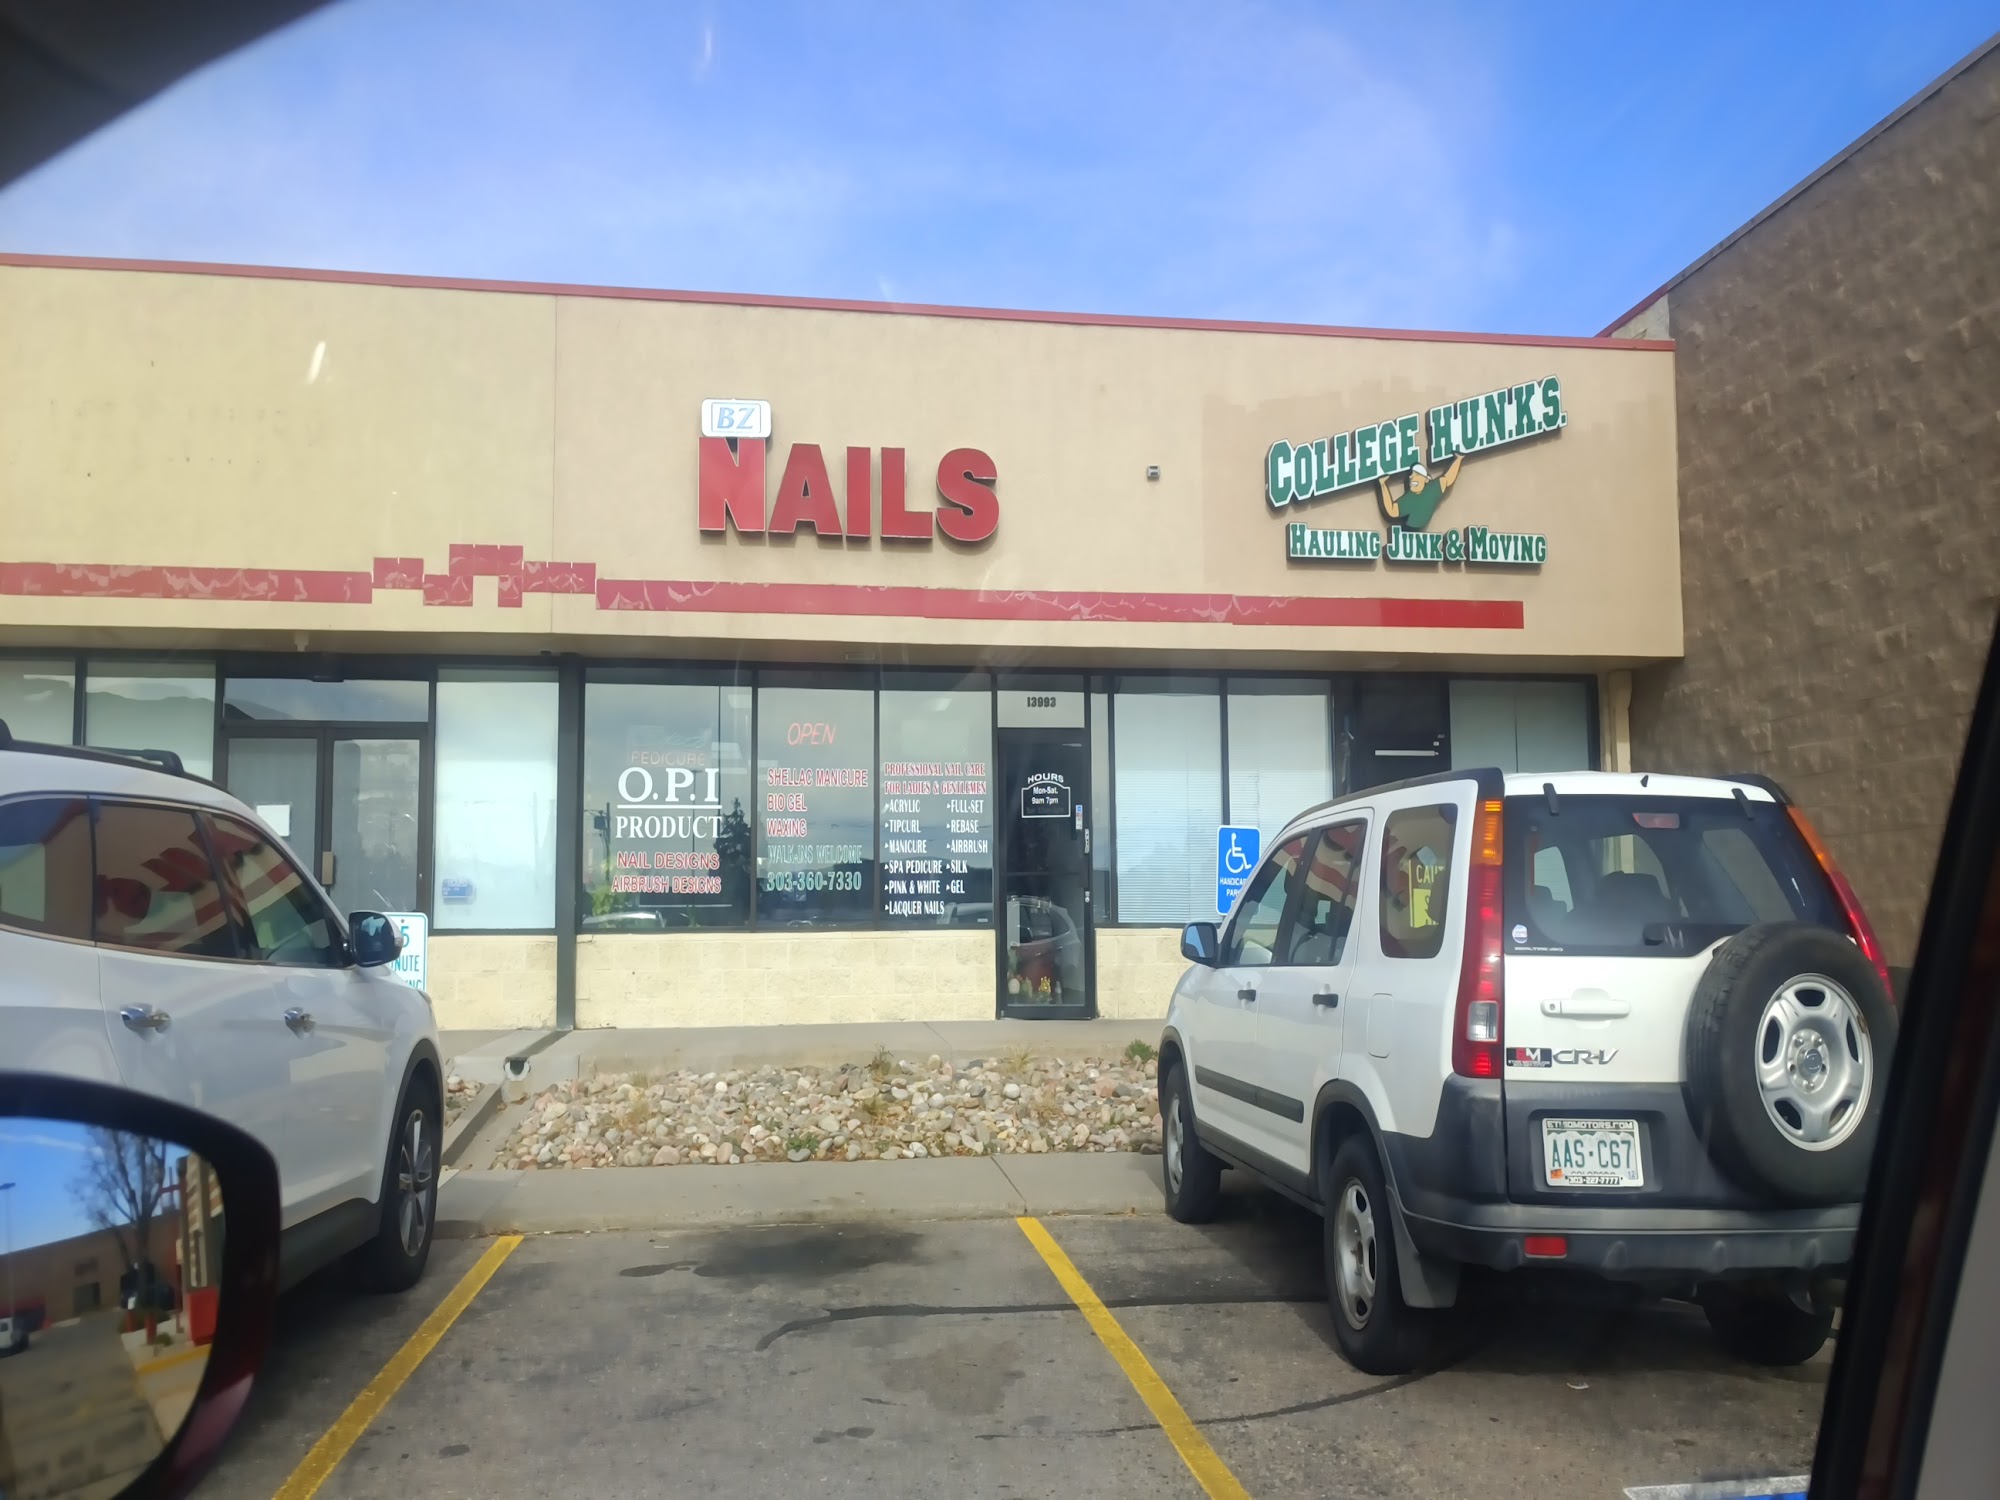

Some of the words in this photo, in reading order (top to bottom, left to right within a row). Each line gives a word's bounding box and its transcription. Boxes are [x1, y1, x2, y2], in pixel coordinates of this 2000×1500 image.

[716, 406, 756, 430] BZ
[1267, 413, 1420, 507] COLLEGE
[697, 436, 1000, 542] NAILS
[1289, 523, 1380, 559] HAULING
[1387, 526, 1443, 560] JUNK
[1446, 528, 1465, 561] &
[1468, 526, 1547, 563] MOVING
[787, 722, 836, 746] OPEN
[631, 750, 705, 767] PEDICURE
[768, 768, 813, 787] SHELLAC
[816, 768, 868, 788] MANICURE
[884, 762, 943, 777] PROFESSIONAL
[944, 762, 964, 777] NAIL
[965, 762, 986, 777] CARE
[1027, 772, 1064, 784] HOURS
[617, 766, 720, 803] O.P.I
[884, 780, 901, 795] FOR
[902, 780, 931, 795] LADIES
[932, 780, 940, 795] &
[941, 780, 987, 795] GENTLEMEN
[767, 793, 785, 812] BIO
[787, 793, 808, 812] GEL
[889, 799, 921, 813] ACRYLIC
[950, 799, 985, 814] FULL-SET
[615, 815, 723, 839] PRODUCT
[766, 818, 808, 838] WAXING
[950, 819, 979, 833] REBASE
[815, 844, 863, 864] WELCOME
[889, 839, 927, 854] MANICURE
[950, 839, 988, 854] AIRBRUSH
[617, 851, 652, 869] NAIL
[654, 852, 720, 870] DESIGNS
[888, 859, 904, 874] SPA
[905, 859, 943, 874] PEDICURE
[950, 859, 968, 874] SILK
[766, 871, 862, 892] 303-360-7330
[1415, 864, 1445, 884] CAU
[611, 874, 670, 894] AIRBRUSH
[671, 875, 722, 894] DESIGNS
[888, 880, 908, 894] PINK
[909, 879, 915, 894] &
[916, 880, 941, 894] WHITE
[950, 879, 966, 894] GEL
[889, 900, 922, 917] LACQUER
[923, 900, 945, 915] NAILS
[1553, 1048, 1619, 1065] CR-V
